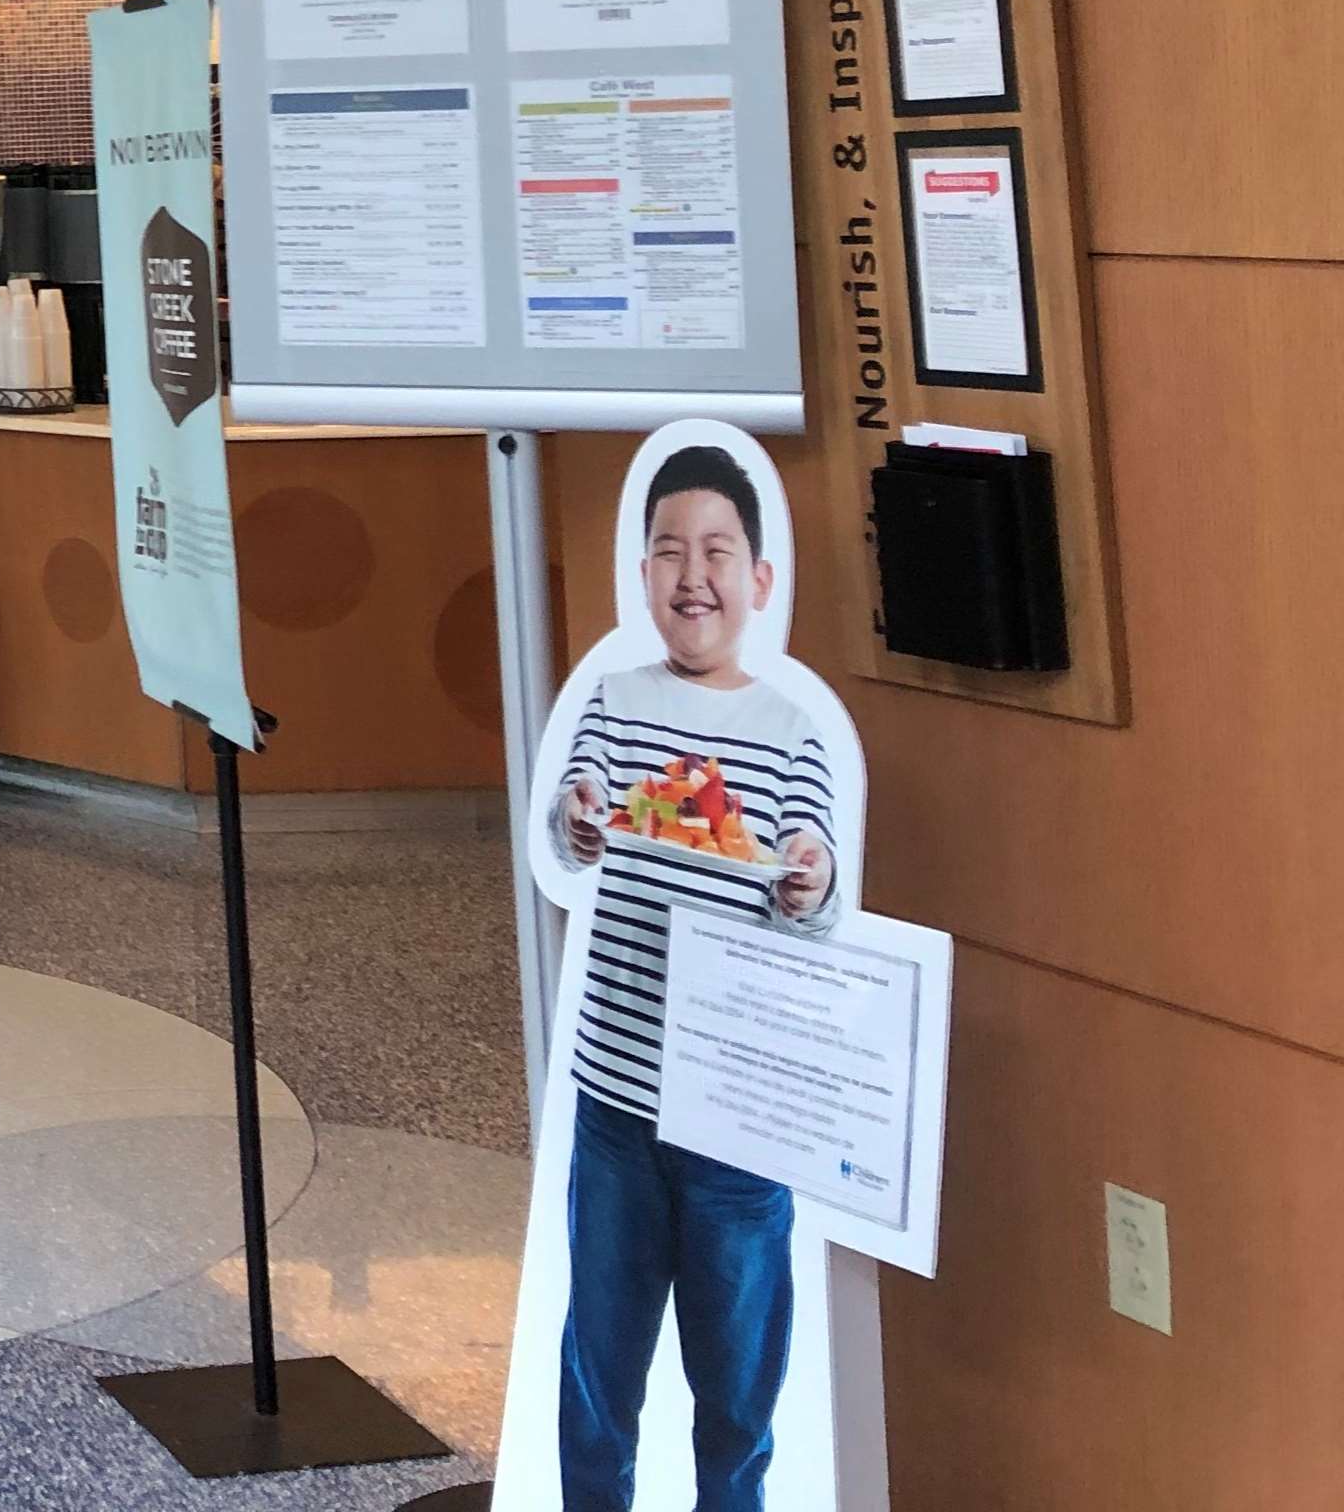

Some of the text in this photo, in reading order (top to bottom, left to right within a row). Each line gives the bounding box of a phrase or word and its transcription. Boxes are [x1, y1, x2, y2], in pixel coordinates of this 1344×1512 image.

[832, 135, 867, 172] &
[840, 198, 890, 430] Nourish,
[153, 327, 198, 359] CFFEE
